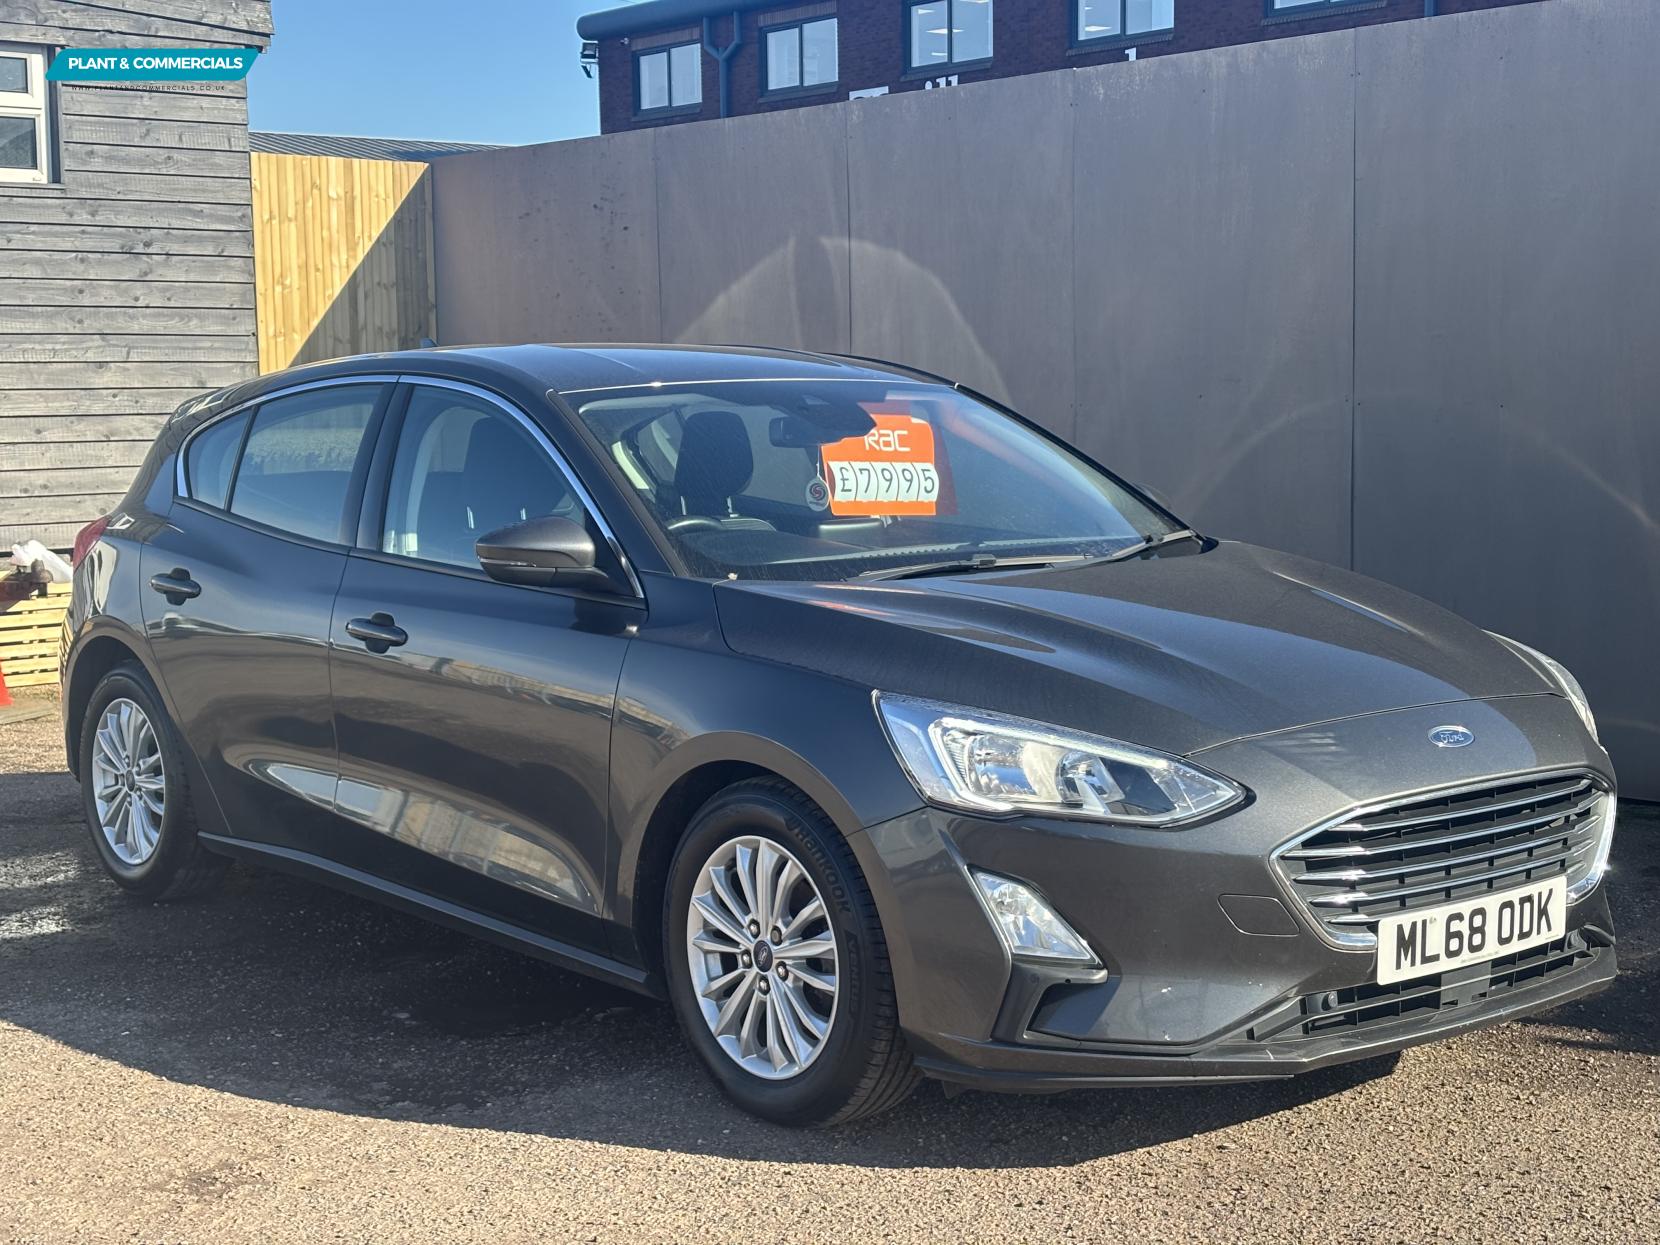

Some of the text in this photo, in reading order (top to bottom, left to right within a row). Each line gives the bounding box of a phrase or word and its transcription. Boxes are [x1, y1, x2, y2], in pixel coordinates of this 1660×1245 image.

[840, 466, 935, 494] £7995
[1396, 888, 1554, 970] ML68 ODK
